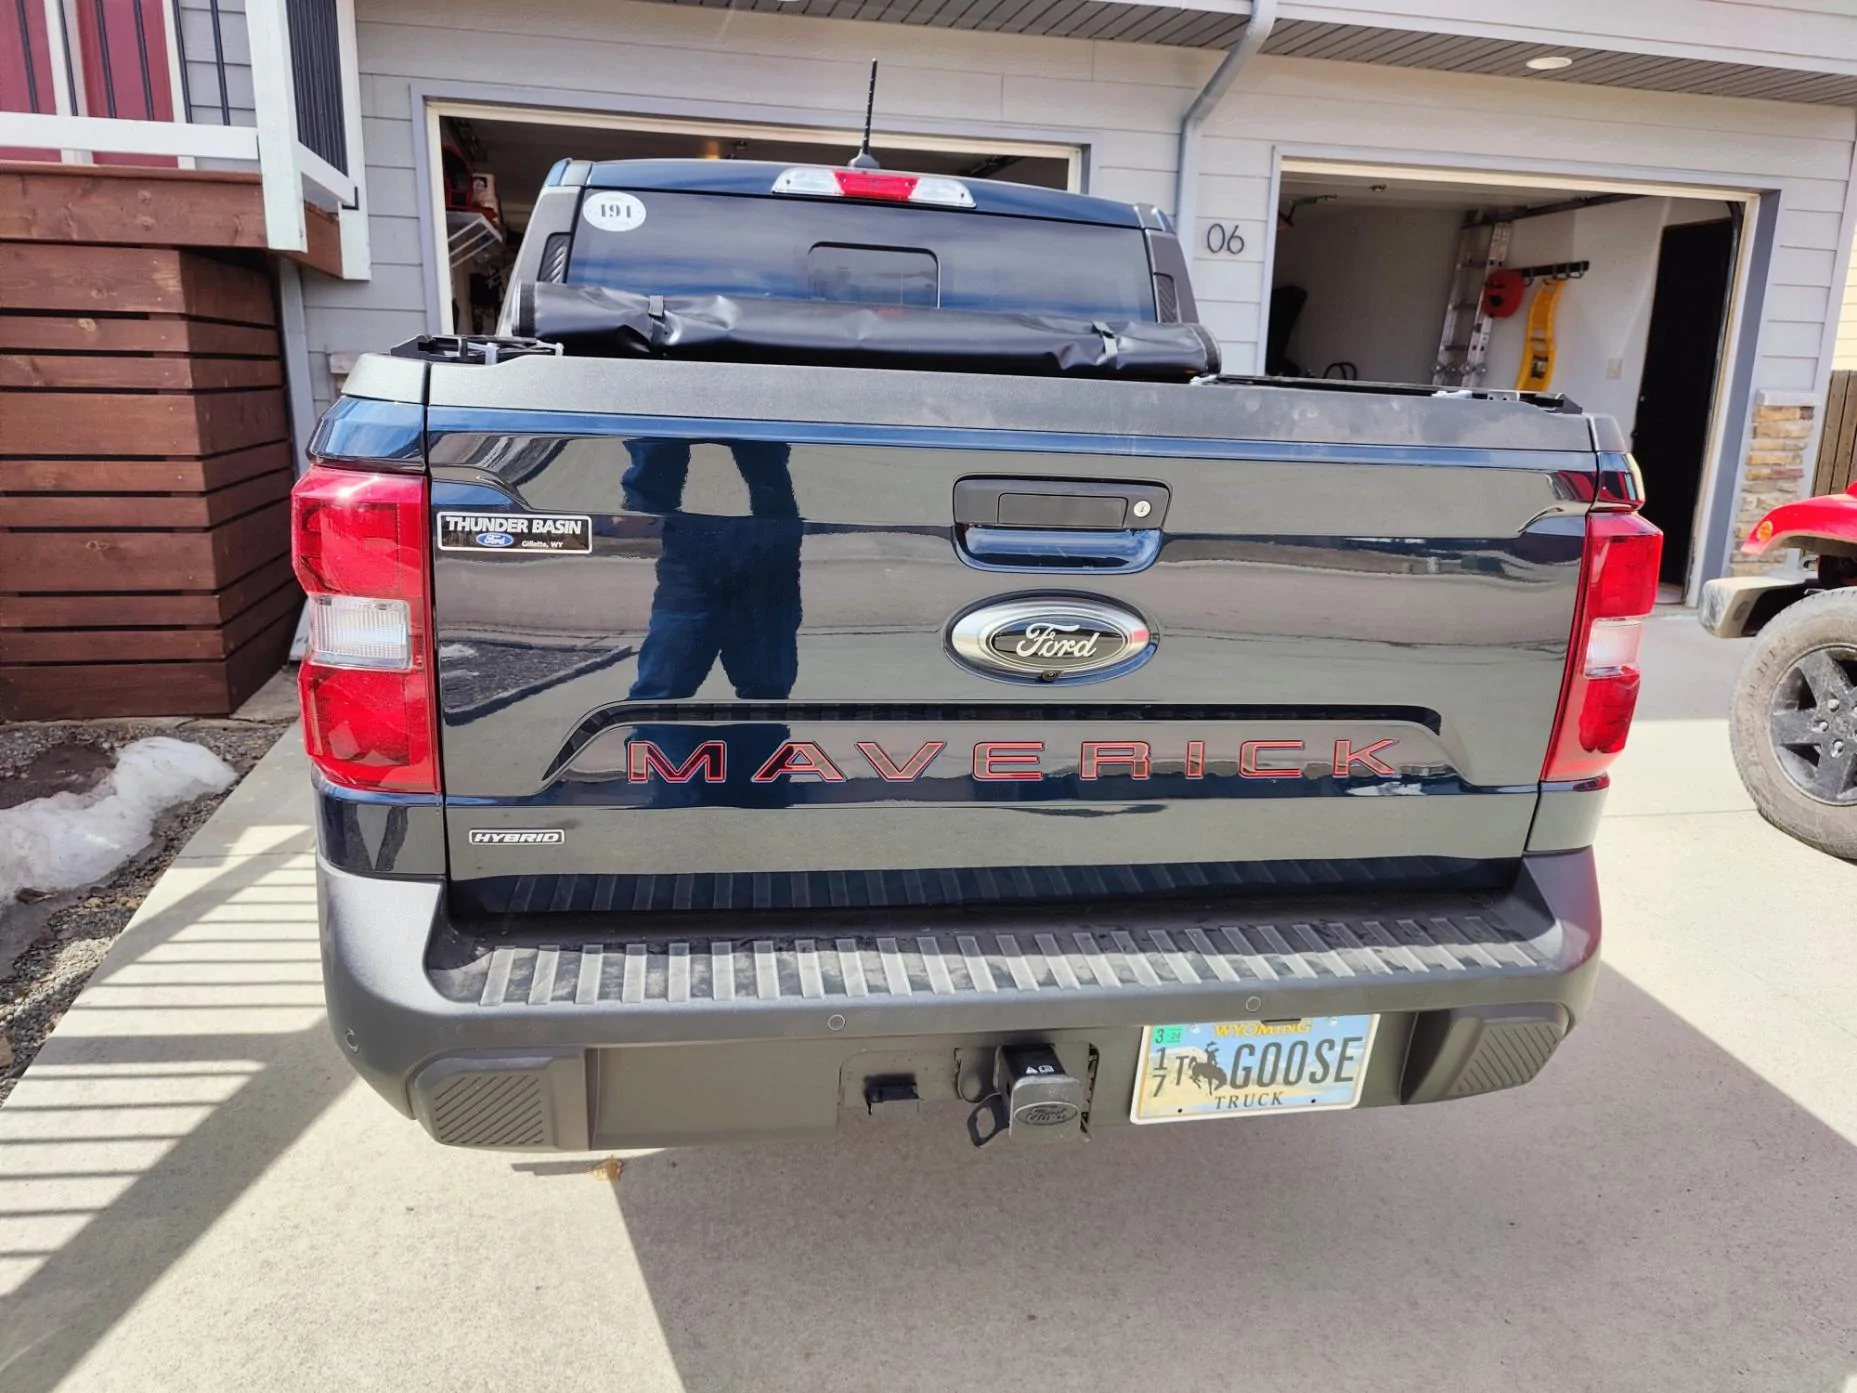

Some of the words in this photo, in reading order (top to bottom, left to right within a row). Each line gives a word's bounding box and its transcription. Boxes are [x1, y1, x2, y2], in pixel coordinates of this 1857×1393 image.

[1207, 223, 1245, 255] 06
[446, 517, 528, 533] THUNDER
[532, 520, 582, 534] BASIN
[483, 535, 506, 545] Ford
[1016, 622, 1100, 657] Ford
[627, 739, 1401, 785] MAVERICK
[474, 833, 560, 843] HYBRID
[1155, 1028, 1165, 1044] 3
[1214, 1019, 1312, 1037] WYOMING
[1229, 1036, 1364, 1090] GOOSE
[1214, 1091, 1285, 1110] TRUCK
